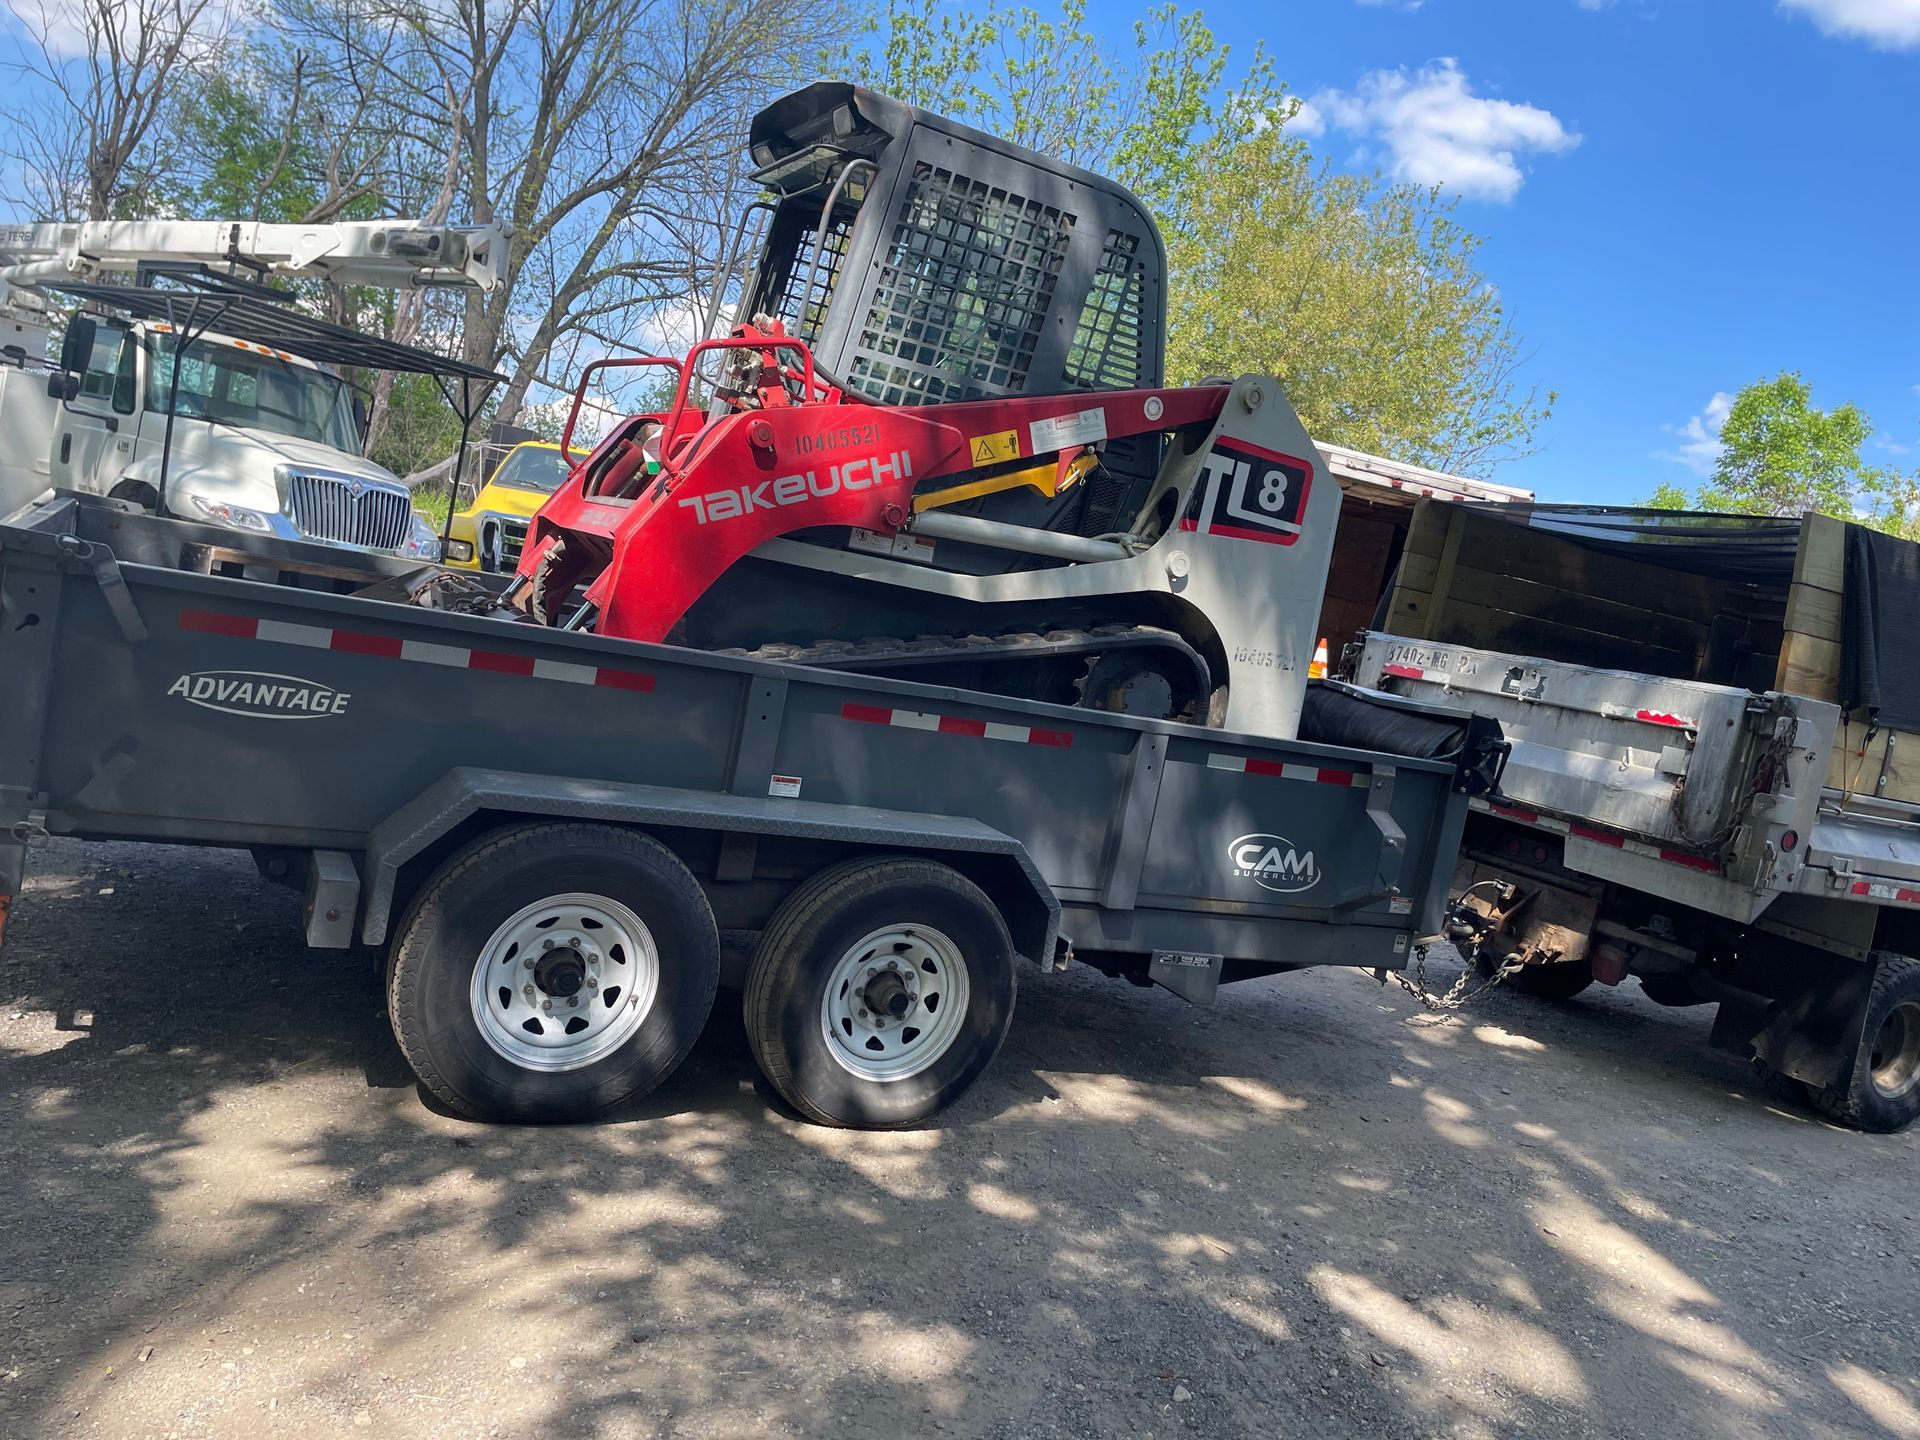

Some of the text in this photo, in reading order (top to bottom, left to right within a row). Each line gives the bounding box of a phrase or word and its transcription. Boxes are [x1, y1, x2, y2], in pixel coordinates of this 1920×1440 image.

[795, 423, 880, 455] 10405521
[167, 674, 351, 714] ADVANTAGE
[1233, 869, 1314, 883] SUPERLINE
[1235, 844, 1314, 876] CAM
